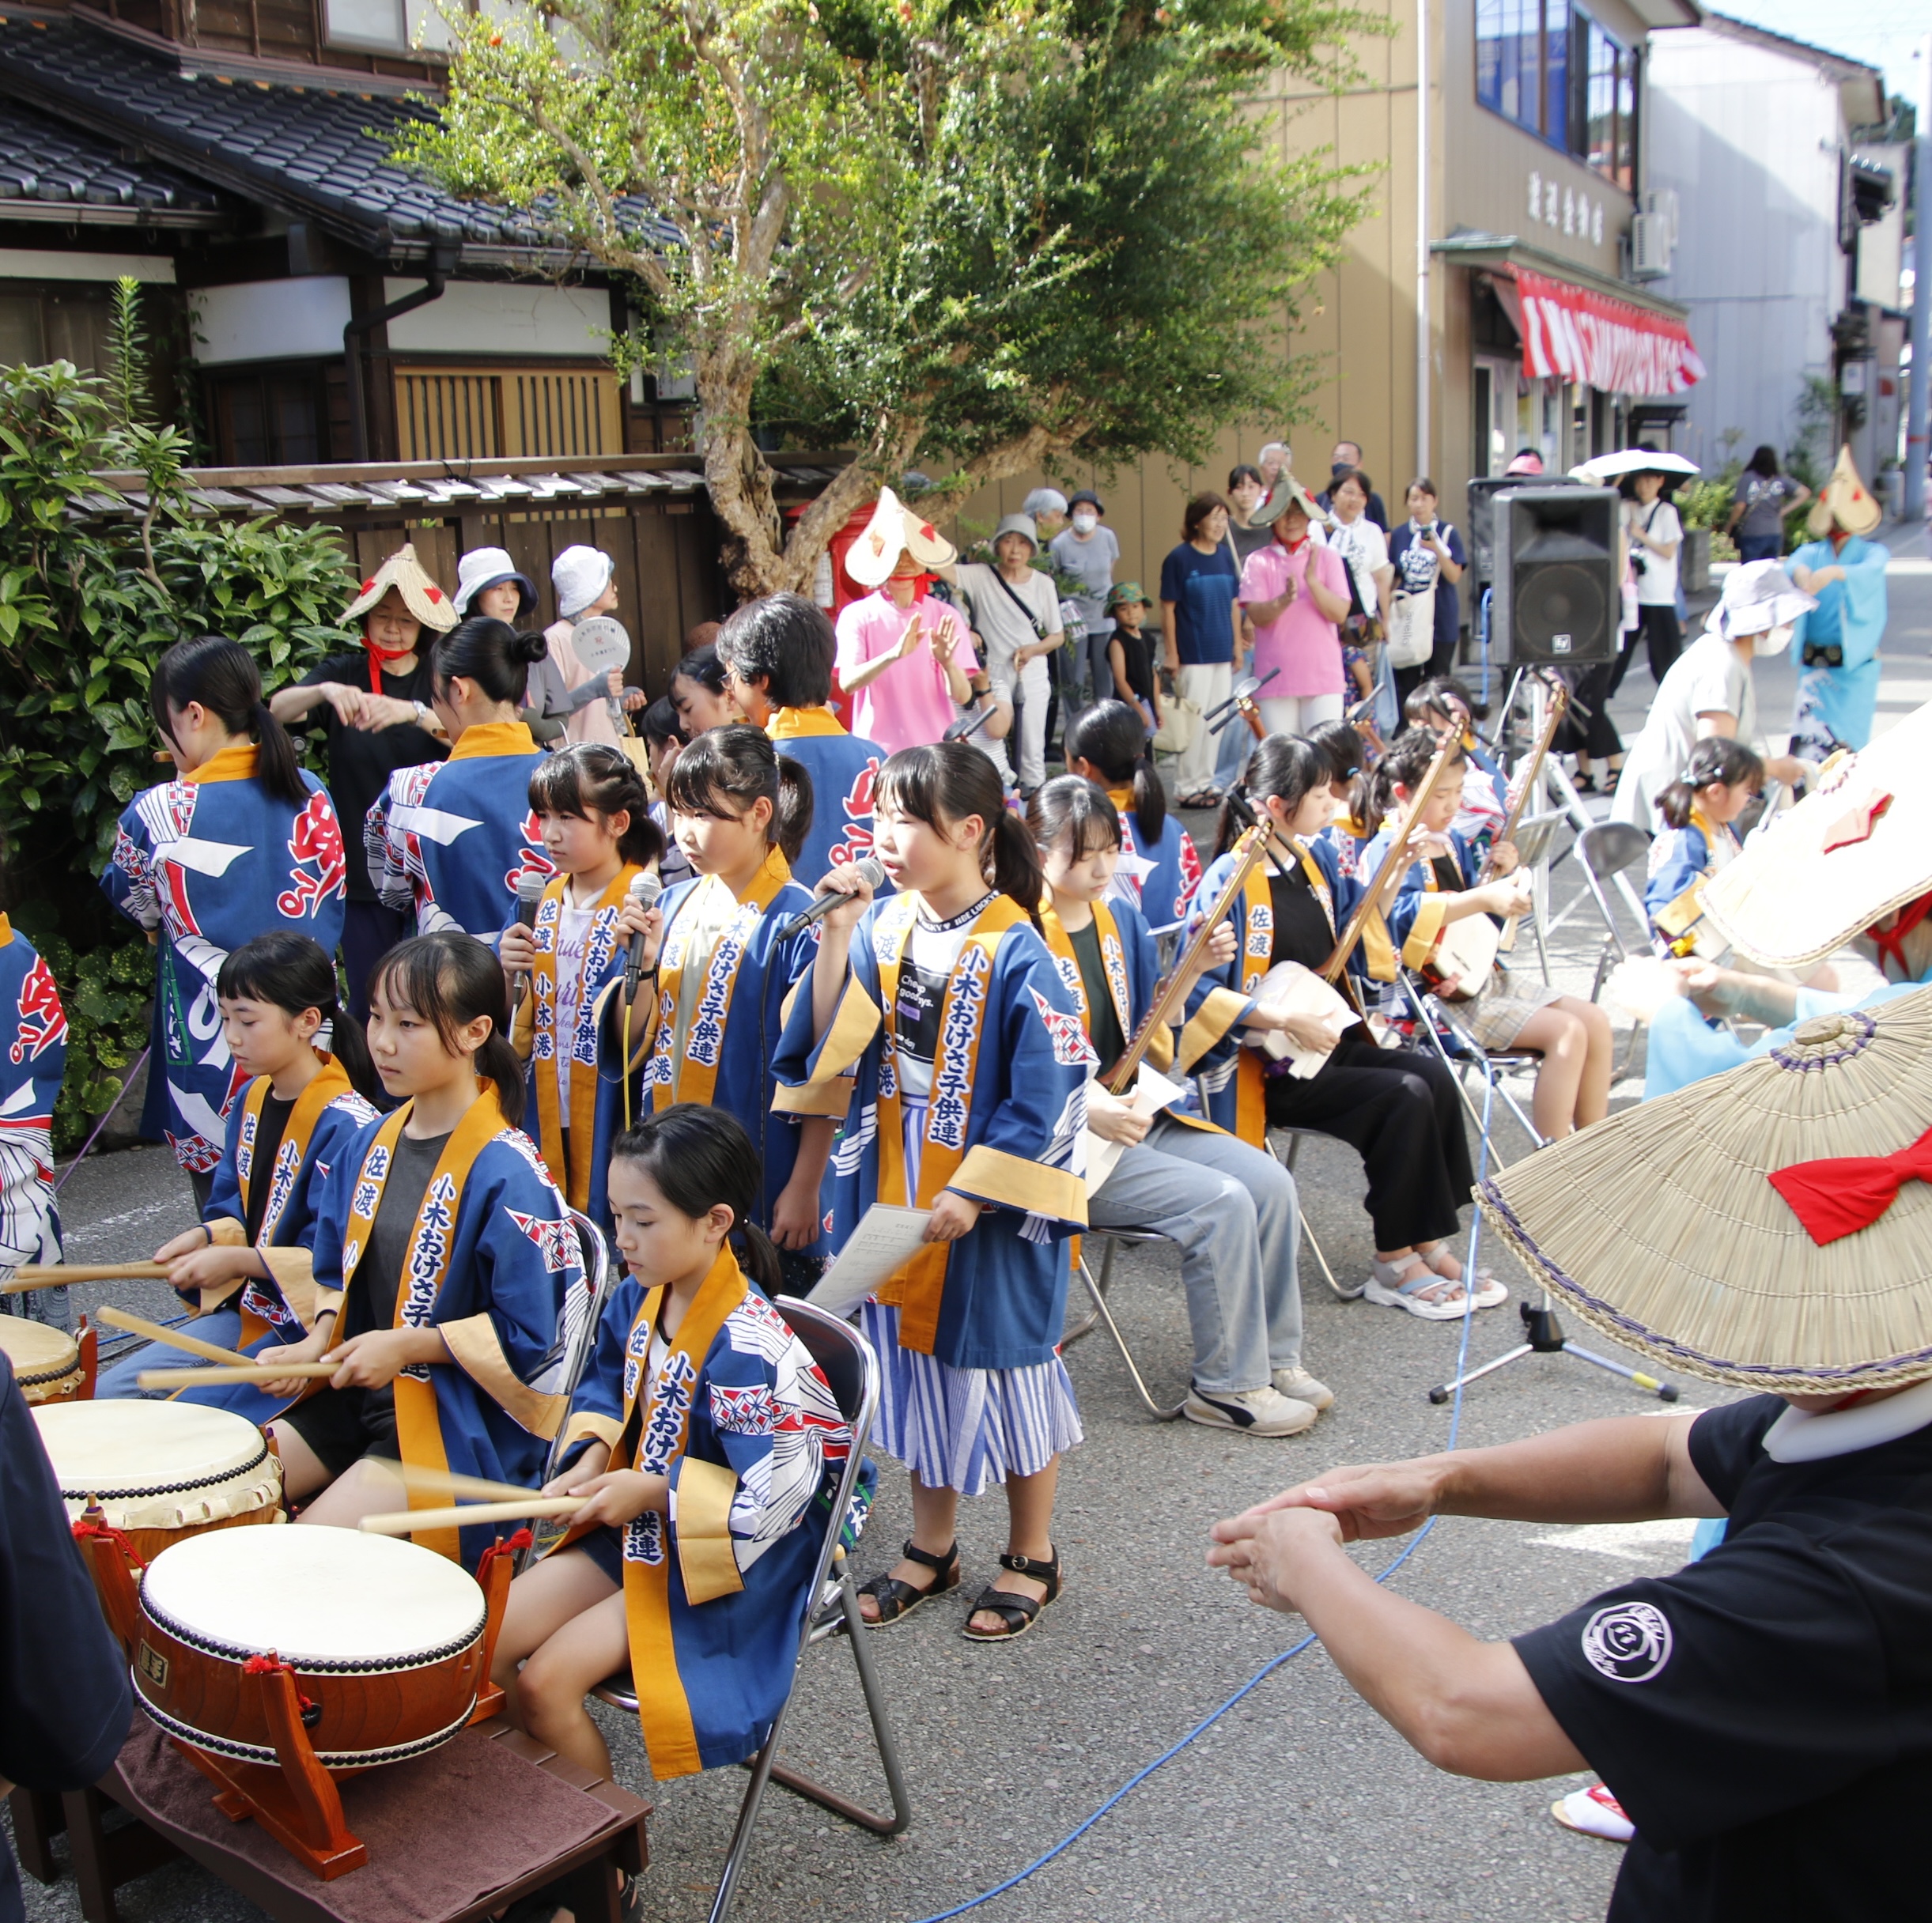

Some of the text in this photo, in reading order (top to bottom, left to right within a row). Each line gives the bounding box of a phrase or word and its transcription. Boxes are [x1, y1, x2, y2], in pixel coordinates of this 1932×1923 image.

[970, 892, 996, 916] LUCKY
[1249, 906, 1272, 957] 佐渡
[535, 972, 554, 1060] 小木港
[686, 901, 762, 1067] 小木おけさ子供連
[653, 990, 674, 1085] 小木港
[928, 944, 989, 1150] 小木おけさ子供連
[239, 1113, 256, 1179] 佐渡
[354, 1146, 389, 1218] 佐渡
[624, 1320, 649, 1399] 佐渡
